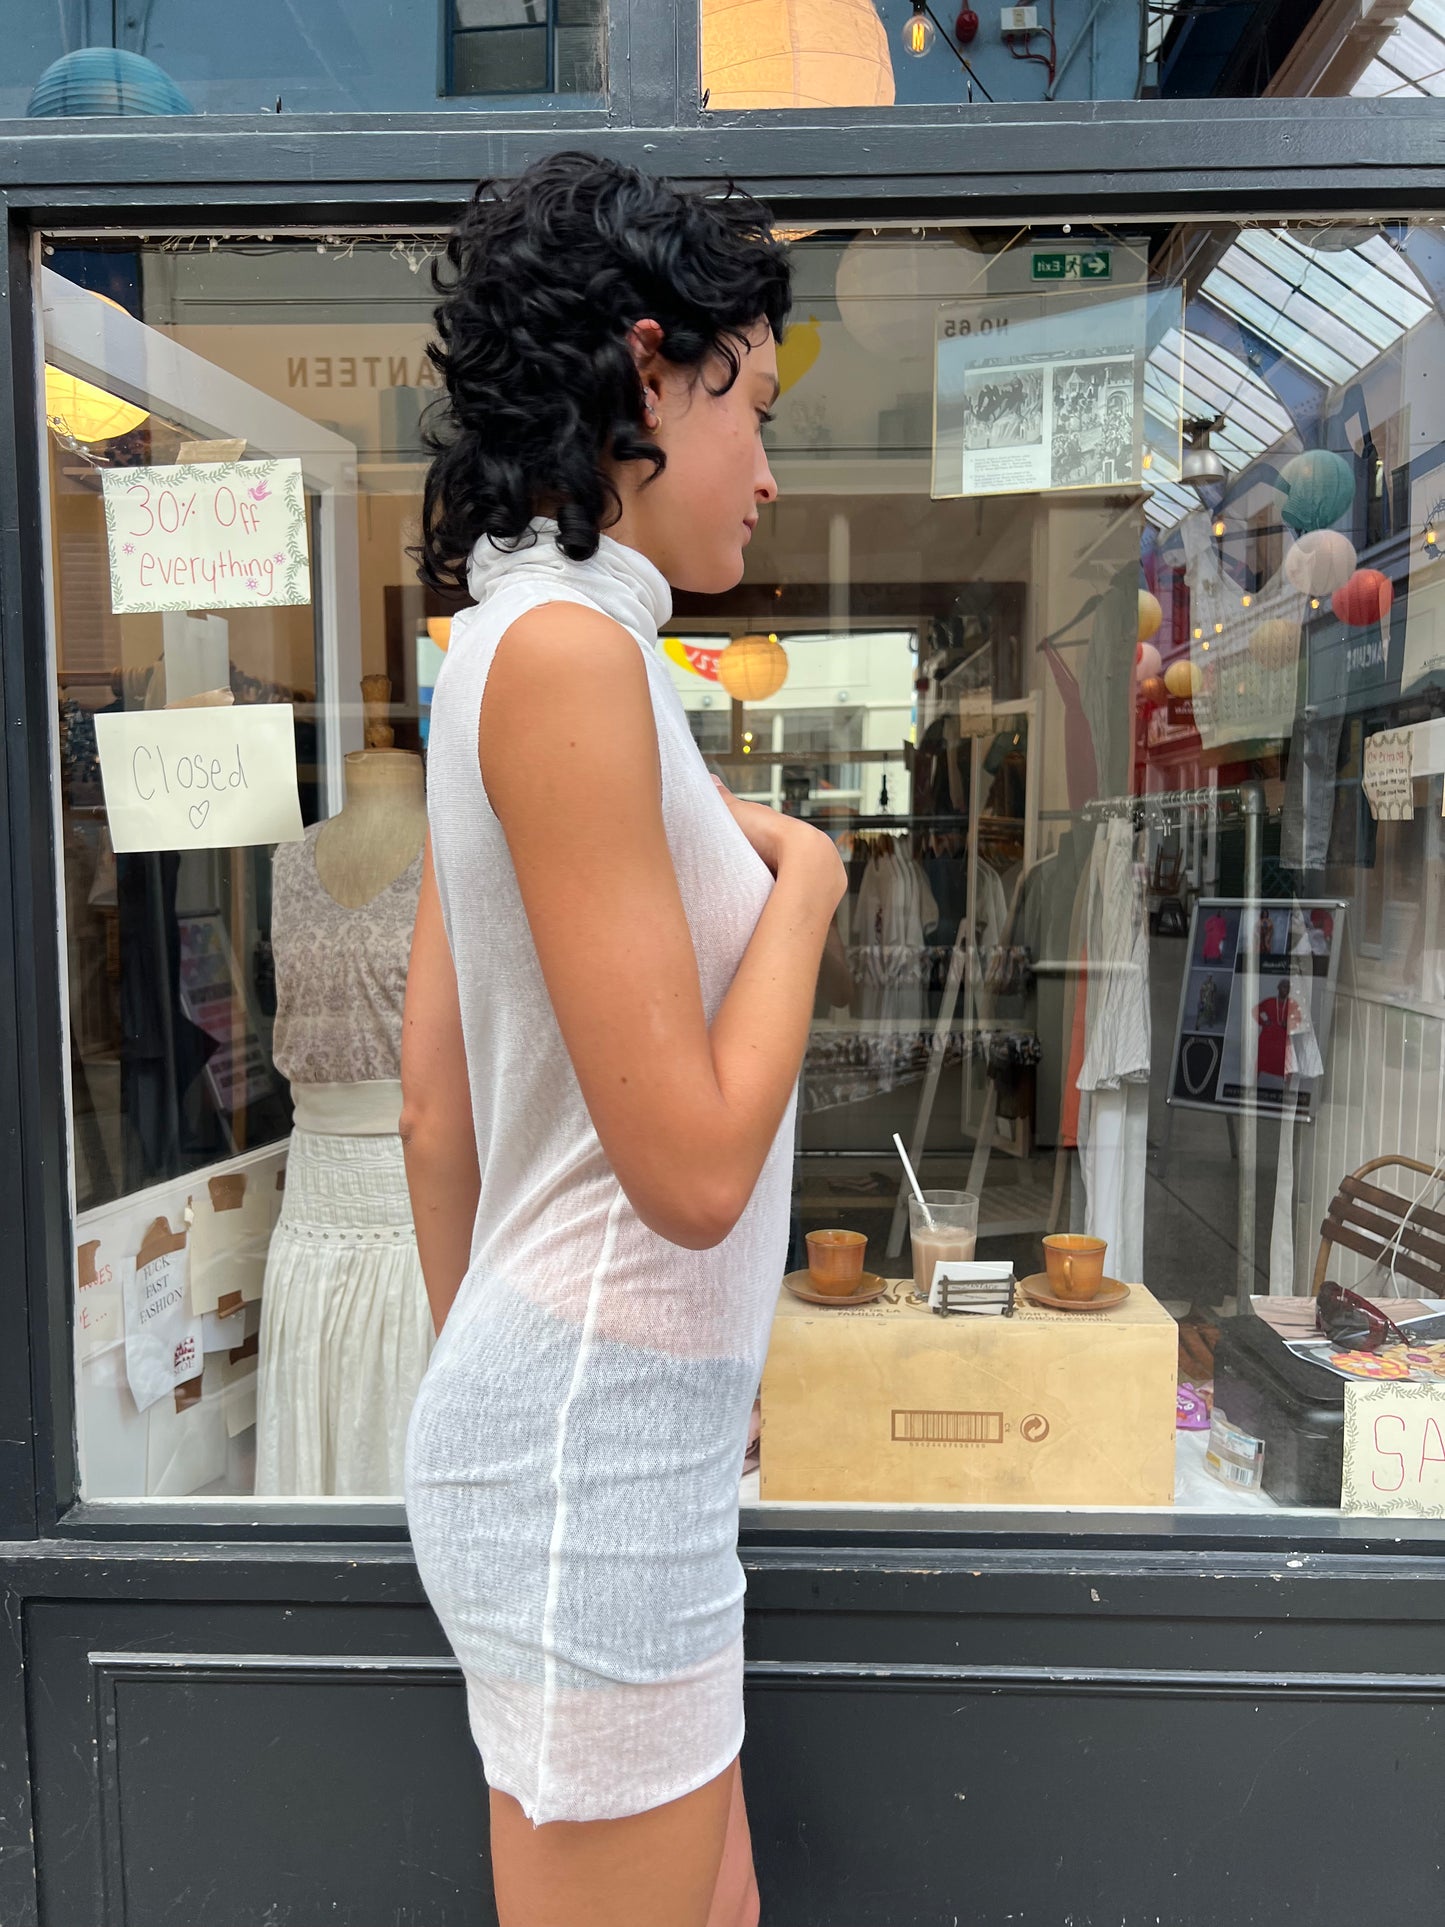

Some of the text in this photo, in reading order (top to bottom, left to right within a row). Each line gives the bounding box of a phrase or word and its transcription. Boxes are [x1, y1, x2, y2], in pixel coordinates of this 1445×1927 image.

[126, 484, 196, 536] 30%
[140, 550, 274, 597] everything
[133, 743, 248, 800] Closed
[143, 1255, 171, 1280] FUCK
[145, 1273, 170, 1299] FAST
[140, 1286, 184, 1325] FASHION
[1372, 1414, 1445, 1491] SA
